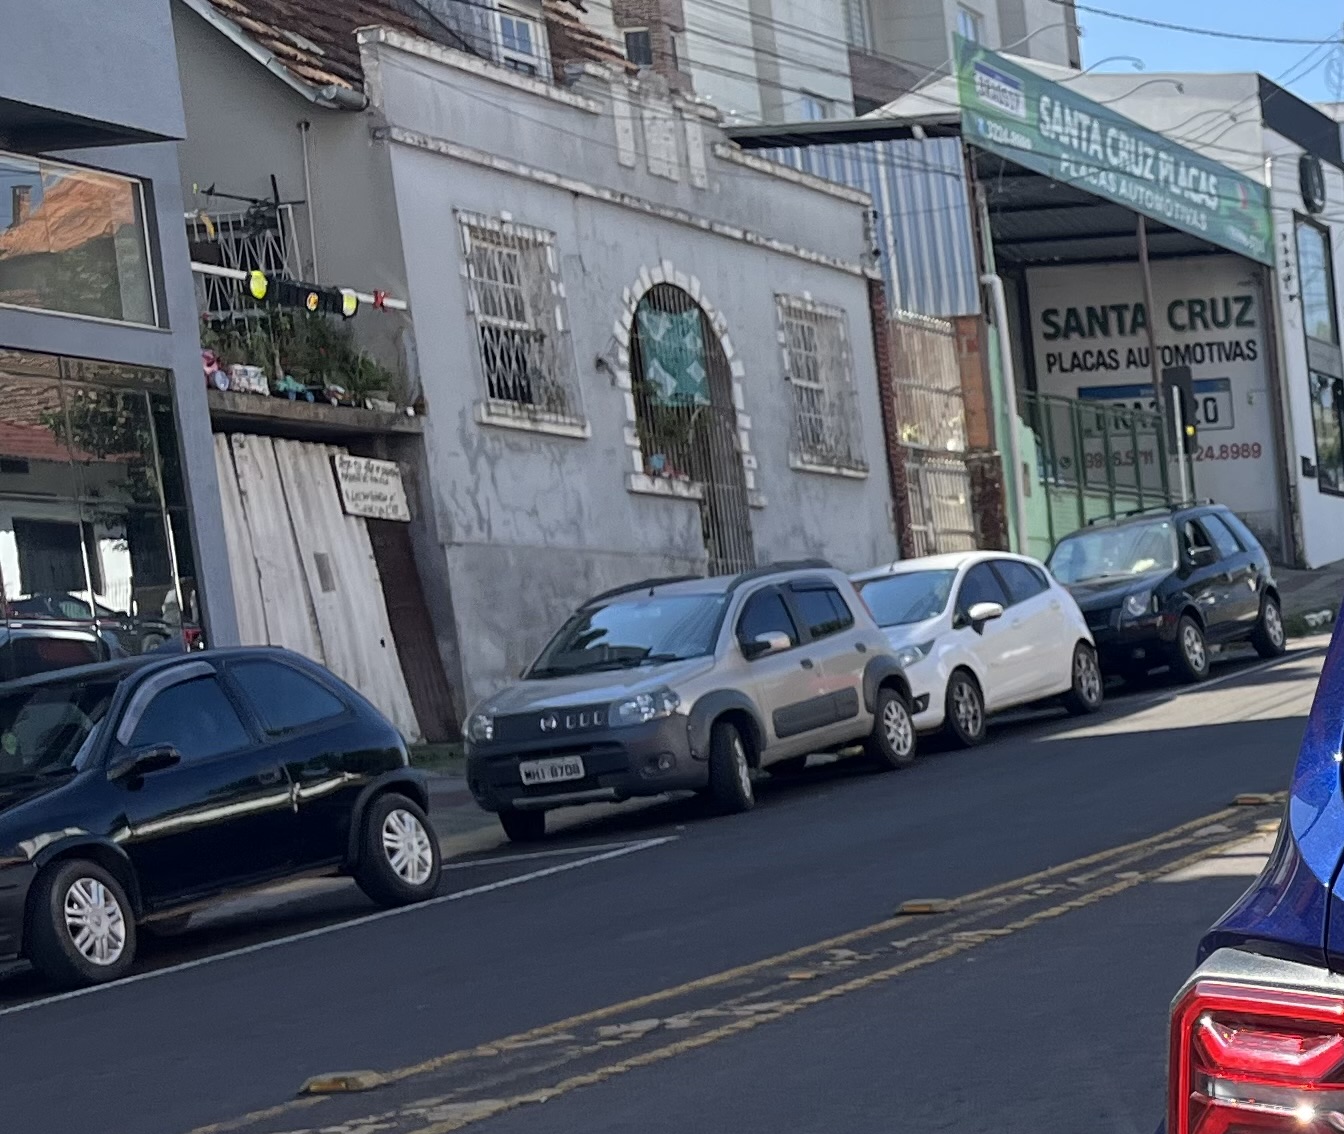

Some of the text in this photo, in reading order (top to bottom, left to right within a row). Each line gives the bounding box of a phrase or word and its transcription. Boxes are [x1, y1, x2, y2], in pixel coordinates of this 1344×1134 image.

[1039, 95, 1218, 210] SANTA CRUZ PLACAS
[1060, 153, 1208, 232] PLACAS AUTOMOTIVAS
[1041, 295, 1256, 341] SANTA CRUZ
[1047, 339, 1258, 374] PLACAS AUOMOTIVAS
